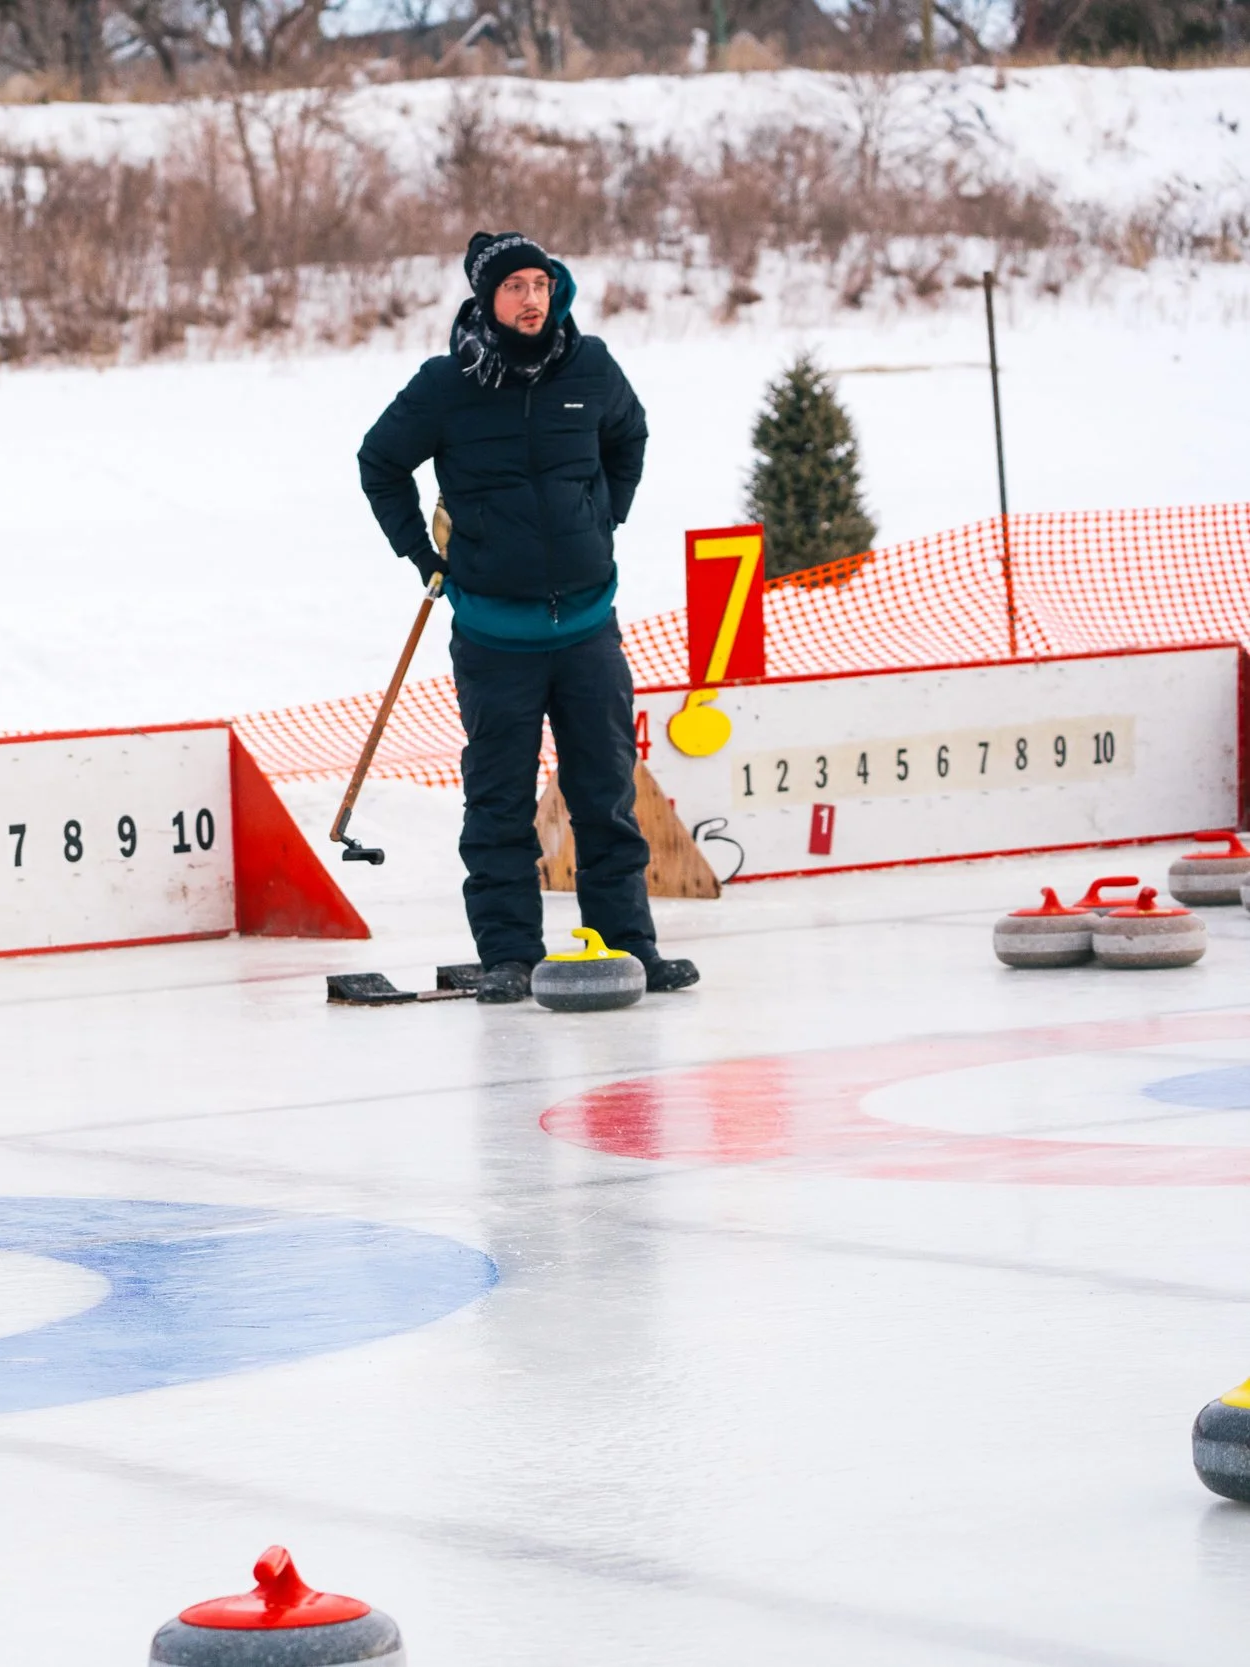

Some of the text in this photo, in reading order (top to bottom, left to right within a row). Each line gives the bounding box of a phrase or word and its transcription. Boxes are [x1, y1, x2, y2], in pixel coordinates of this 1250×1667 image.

[694, 535, 762, 682] 7
[742, 731, 1116, 796] 1 2 3 4 5 6 7 8 9 10
[8, 823, 27, 867] 7
[63, 819, 83, 863] 8
[117, 815, 137, 858] 9
[171, 808, 215, 854] 10
[818, 807, 830, 834] 1
